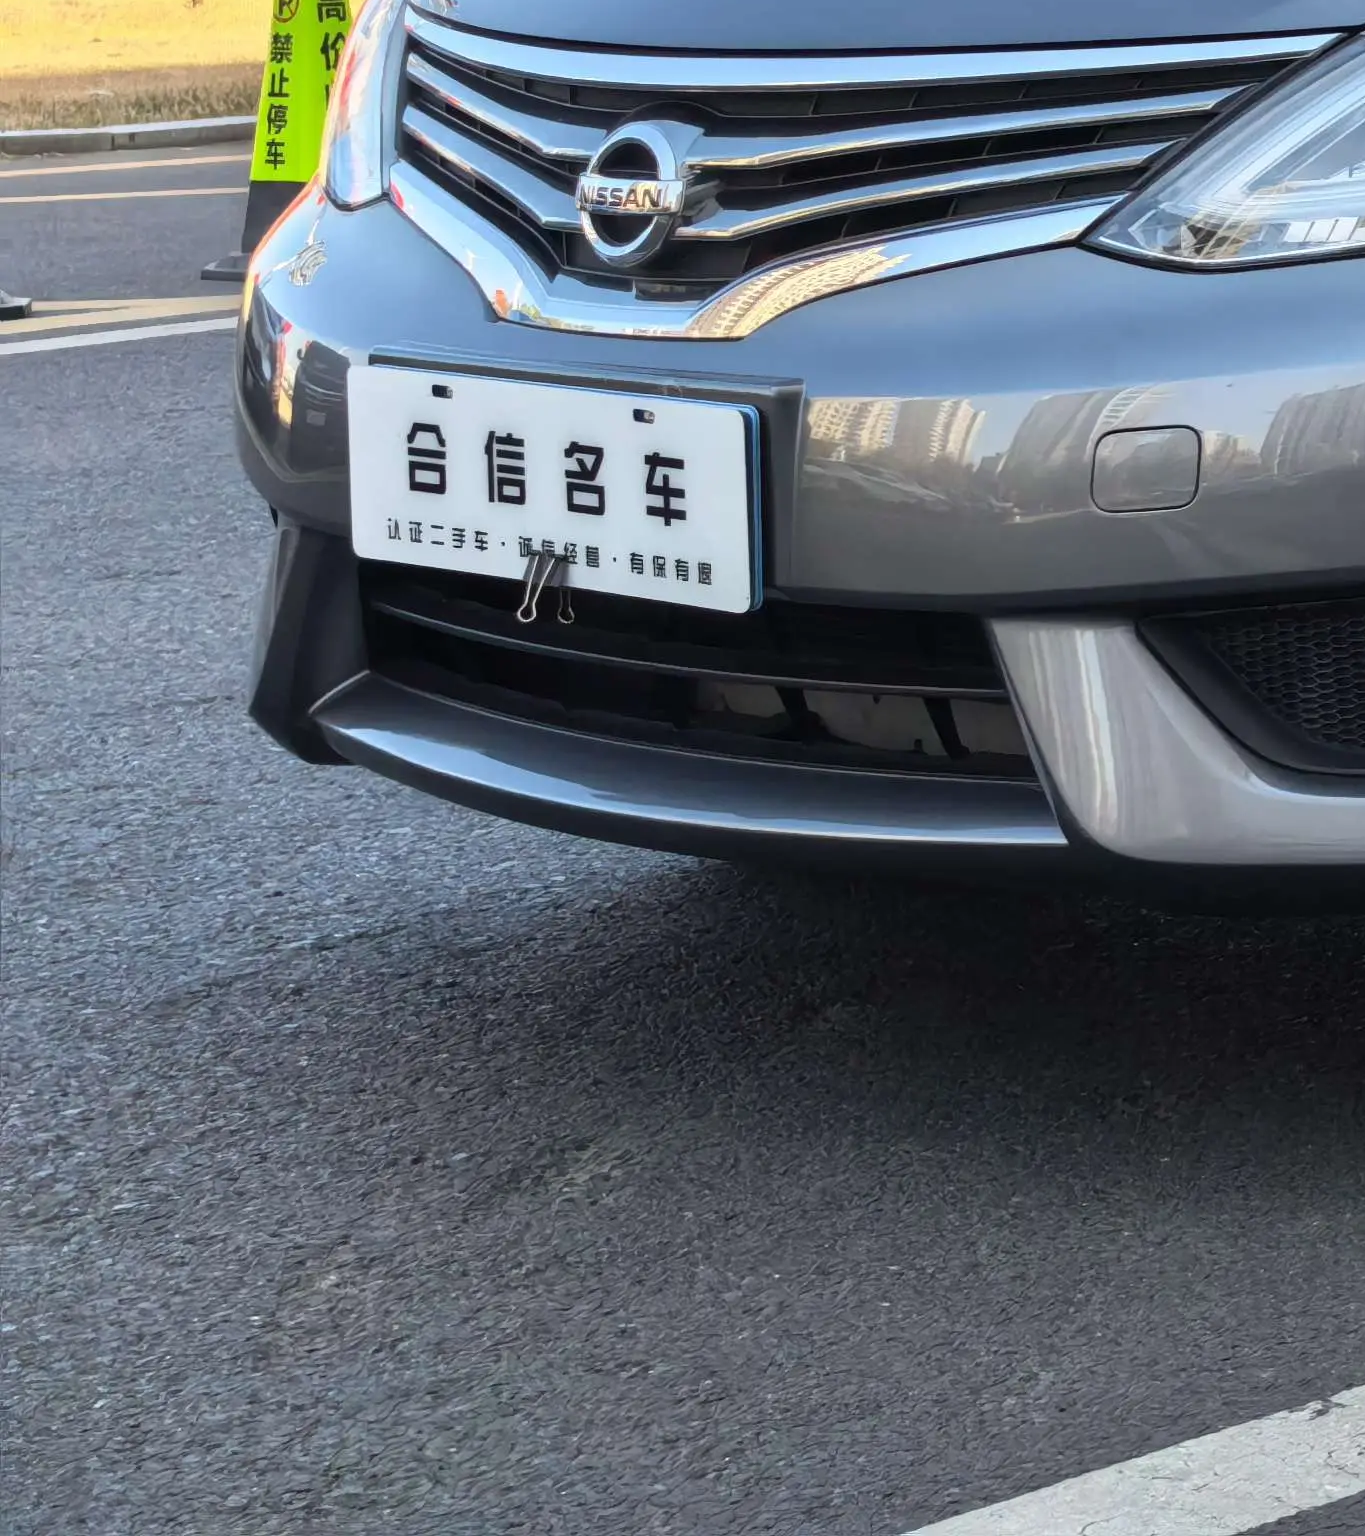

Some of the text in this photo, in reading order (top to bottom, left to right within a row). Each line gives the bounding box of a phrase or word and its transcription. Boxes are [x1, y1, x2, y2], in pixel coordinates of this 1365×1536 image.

[265, 31, 294, 170] 禁止停车
[580, 183, 662, 208] NISSAN
[406, 421, 687, 527] 合信名车
